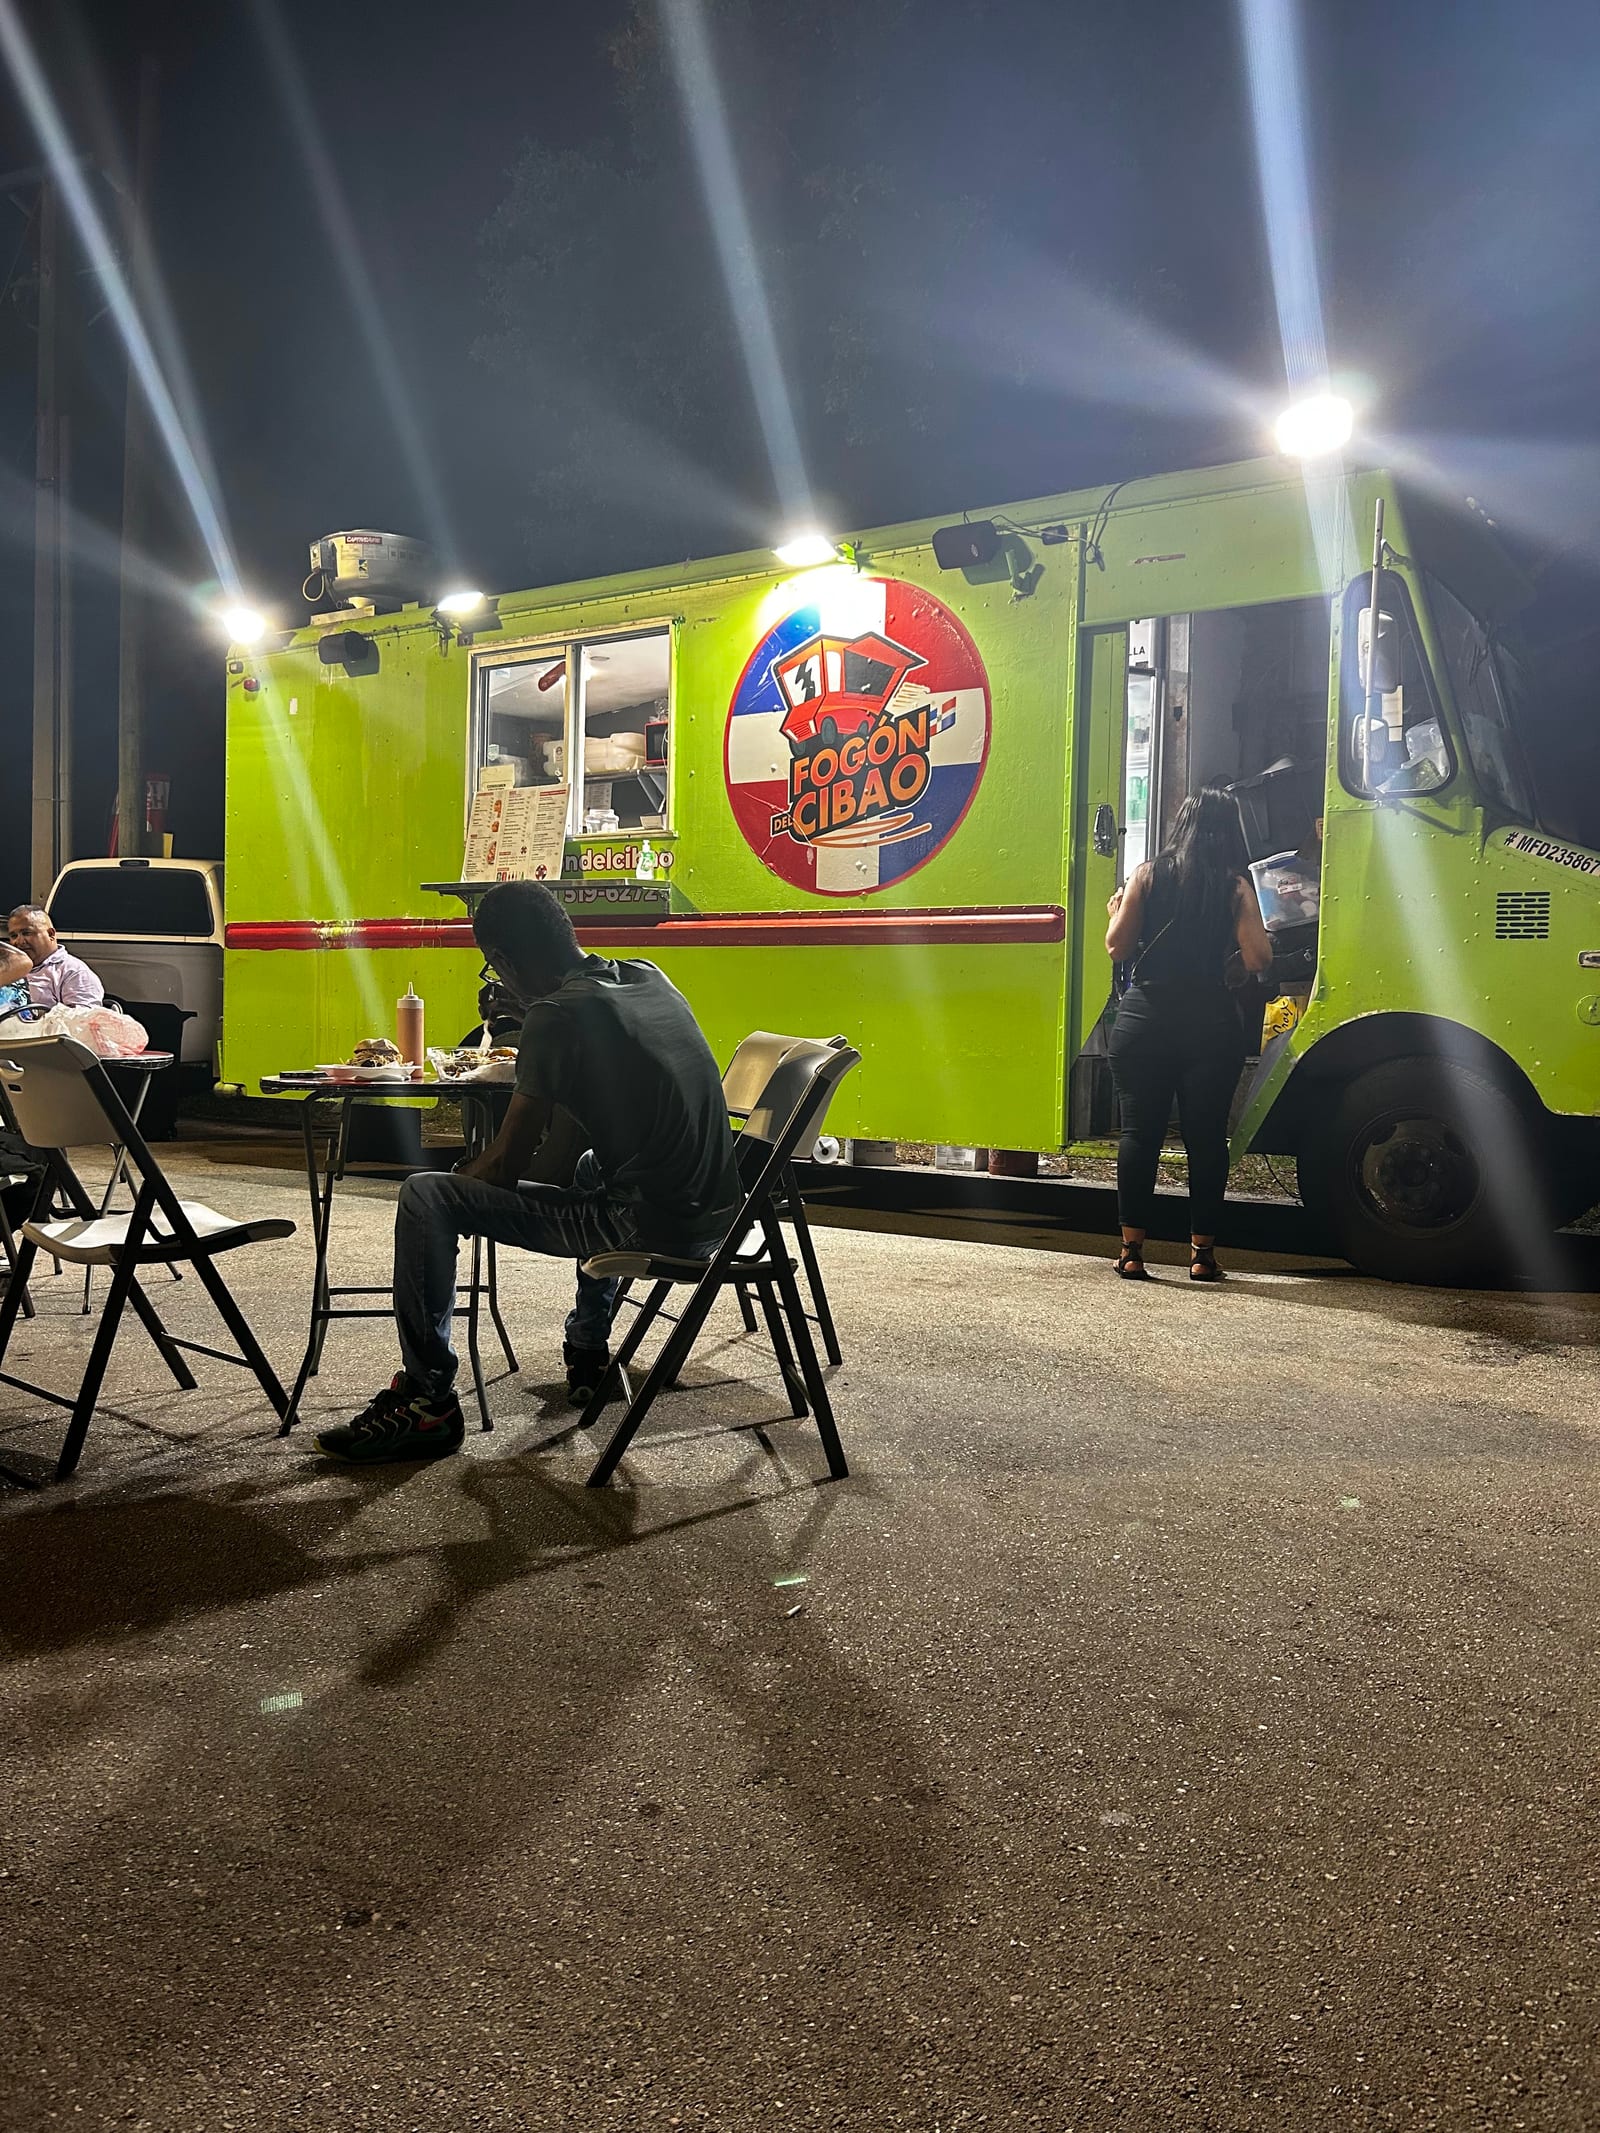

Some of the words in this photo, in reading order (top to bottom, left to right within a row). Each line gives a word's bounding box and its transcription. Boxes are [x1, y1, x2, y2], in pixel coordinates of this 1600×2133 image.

[793, 711, 927, 793] FOGÓN
[774, 816, 792, 832] DEL
[793, 753, 926, 836] CIBAO
